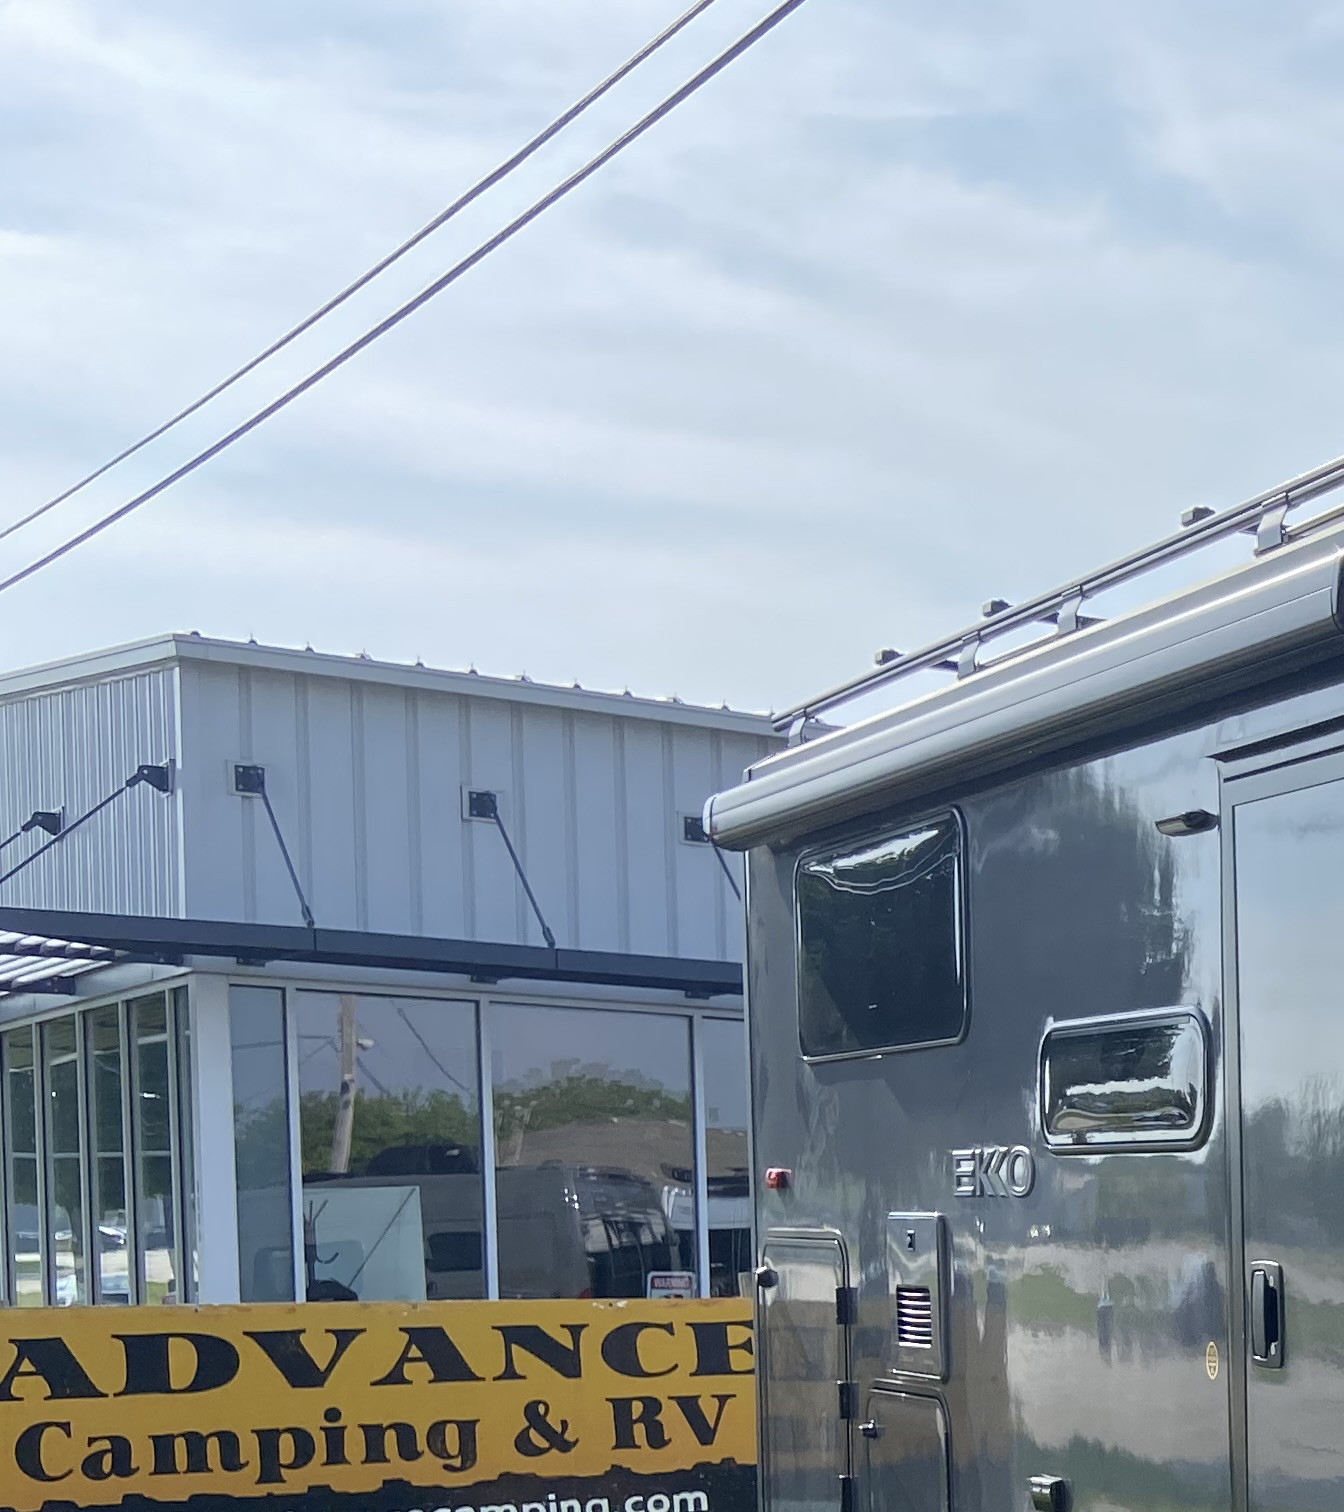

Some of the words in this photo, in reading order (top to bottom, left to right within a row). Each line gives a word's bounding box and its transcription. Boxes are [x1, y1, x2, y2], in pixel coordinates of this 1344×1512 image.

[951, 1145, 1036, 1198] EKKO
[0, 1318, 757, 1402] ADVANCE
[13, 1406, 481, 1485] Camping
[513, 1399, 580, 1458] &
[607, 1393, 738, 1451] RV
